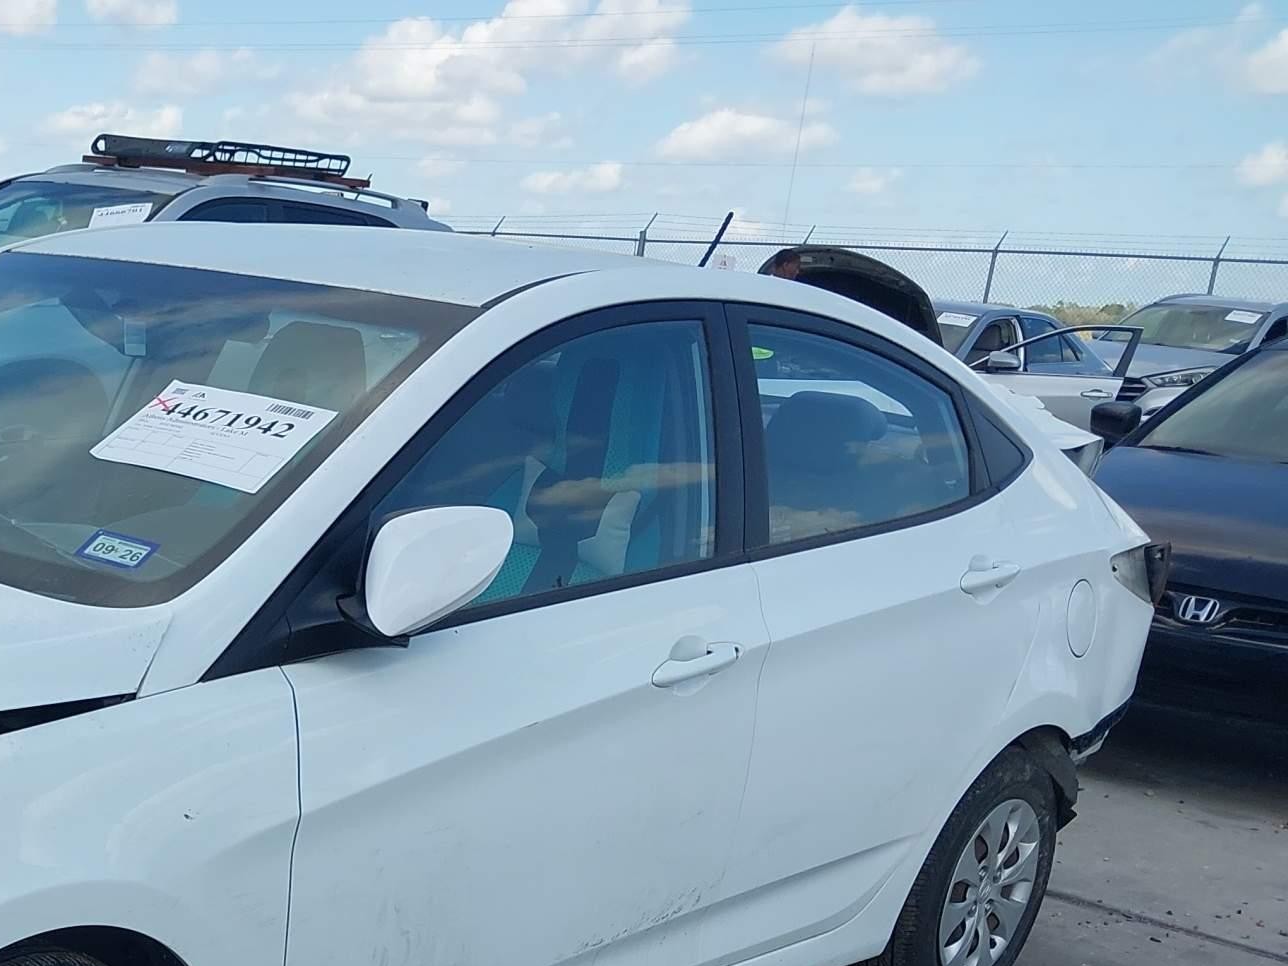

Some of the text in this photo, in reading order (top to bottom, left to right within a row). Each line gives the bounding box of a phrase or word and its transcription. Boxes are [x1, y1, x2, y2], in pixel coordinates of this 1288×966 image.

[161, 402, 295, 439] 44671942
[92, 542, 116, 555] 09
[118, 549, 143, 562] 26
